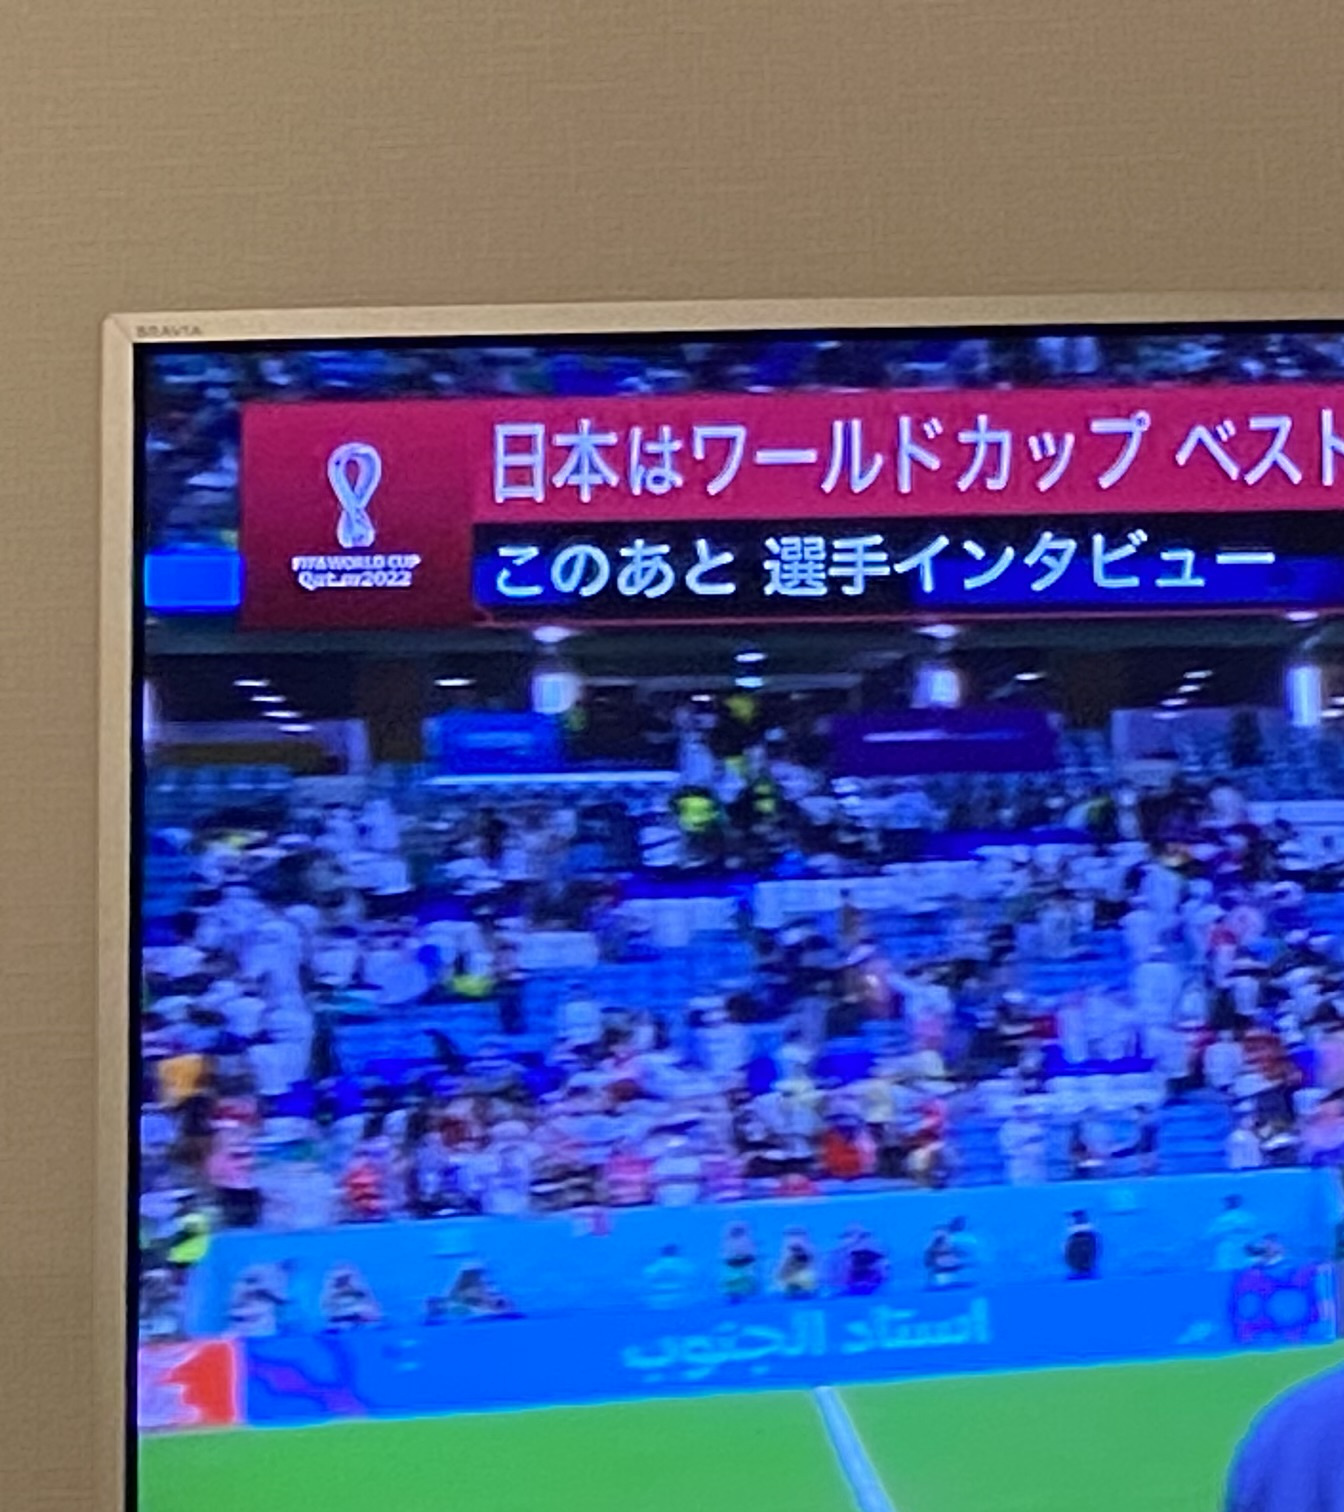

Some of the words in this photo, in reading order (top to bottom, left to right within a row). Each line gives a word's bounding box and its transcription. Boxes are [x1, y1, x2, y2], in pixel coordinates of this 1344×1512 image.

[493, 410, 1150, 504] 日本はワールドカップ
[494, 536, 738, 598] このあと
[763, 529, 1277, 597] 選手インタビュー
